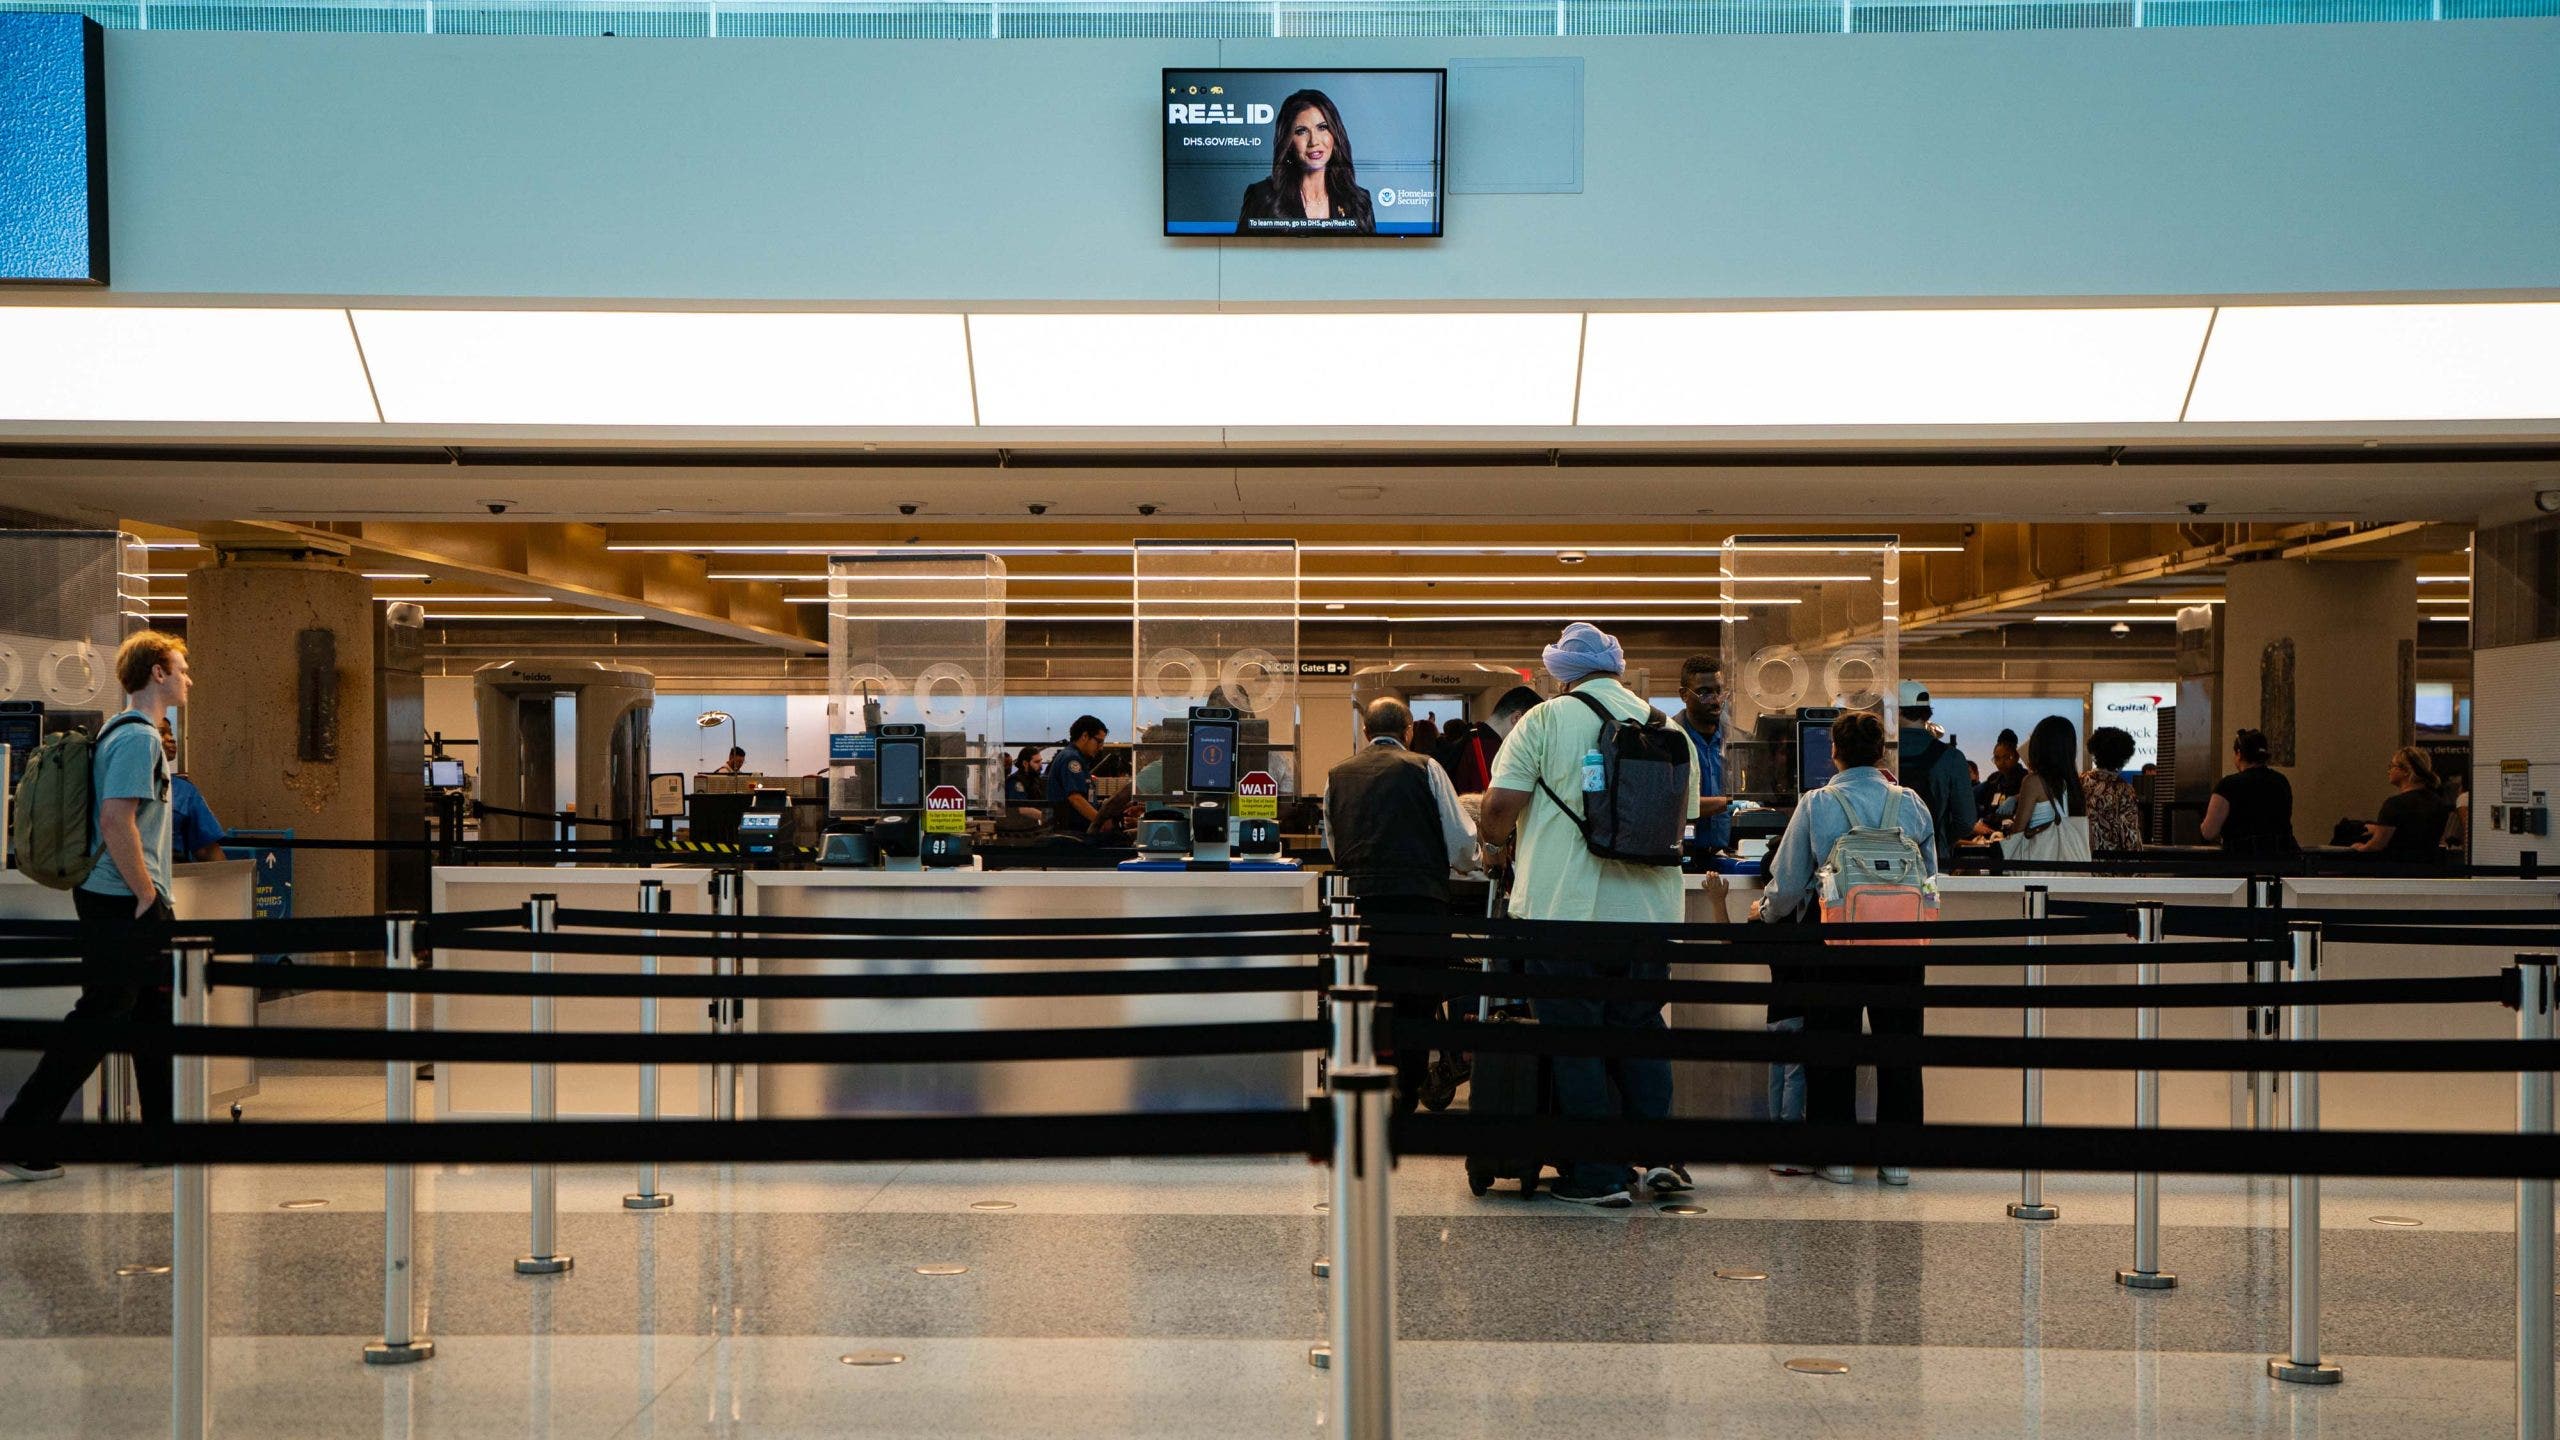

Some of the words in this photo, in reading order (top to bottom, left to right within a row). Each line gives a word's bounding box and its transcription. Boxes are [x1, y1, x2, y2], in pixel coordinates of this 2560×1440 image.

[1168, 103, 1244, 125] REAL
[1246, 103, 1275, 125] ID
[1183, 137, 1262, 147] DHS.GOV/REAL-ID
[1397, 197, 1430, 208] Security
[1249, 219, 1257, 227] To
[1258, 219, 1273, 227] learn
[1274, 220, 1291, 229] more,
[1292, 220, 1300, 228] go
[1300, 219, 1307, 227] to
[1301, 663, 1326, 672] Gates
[522, 672, 552, 682] leidos
[1431, 674, 1461, 685] leidos
[2107, 703, 2146, 713] Capital
[1240, 783, 1276, 795] WAIT
[928, 797, 963, 809] WAIT
[256, 886, 273, 894] MPTY
